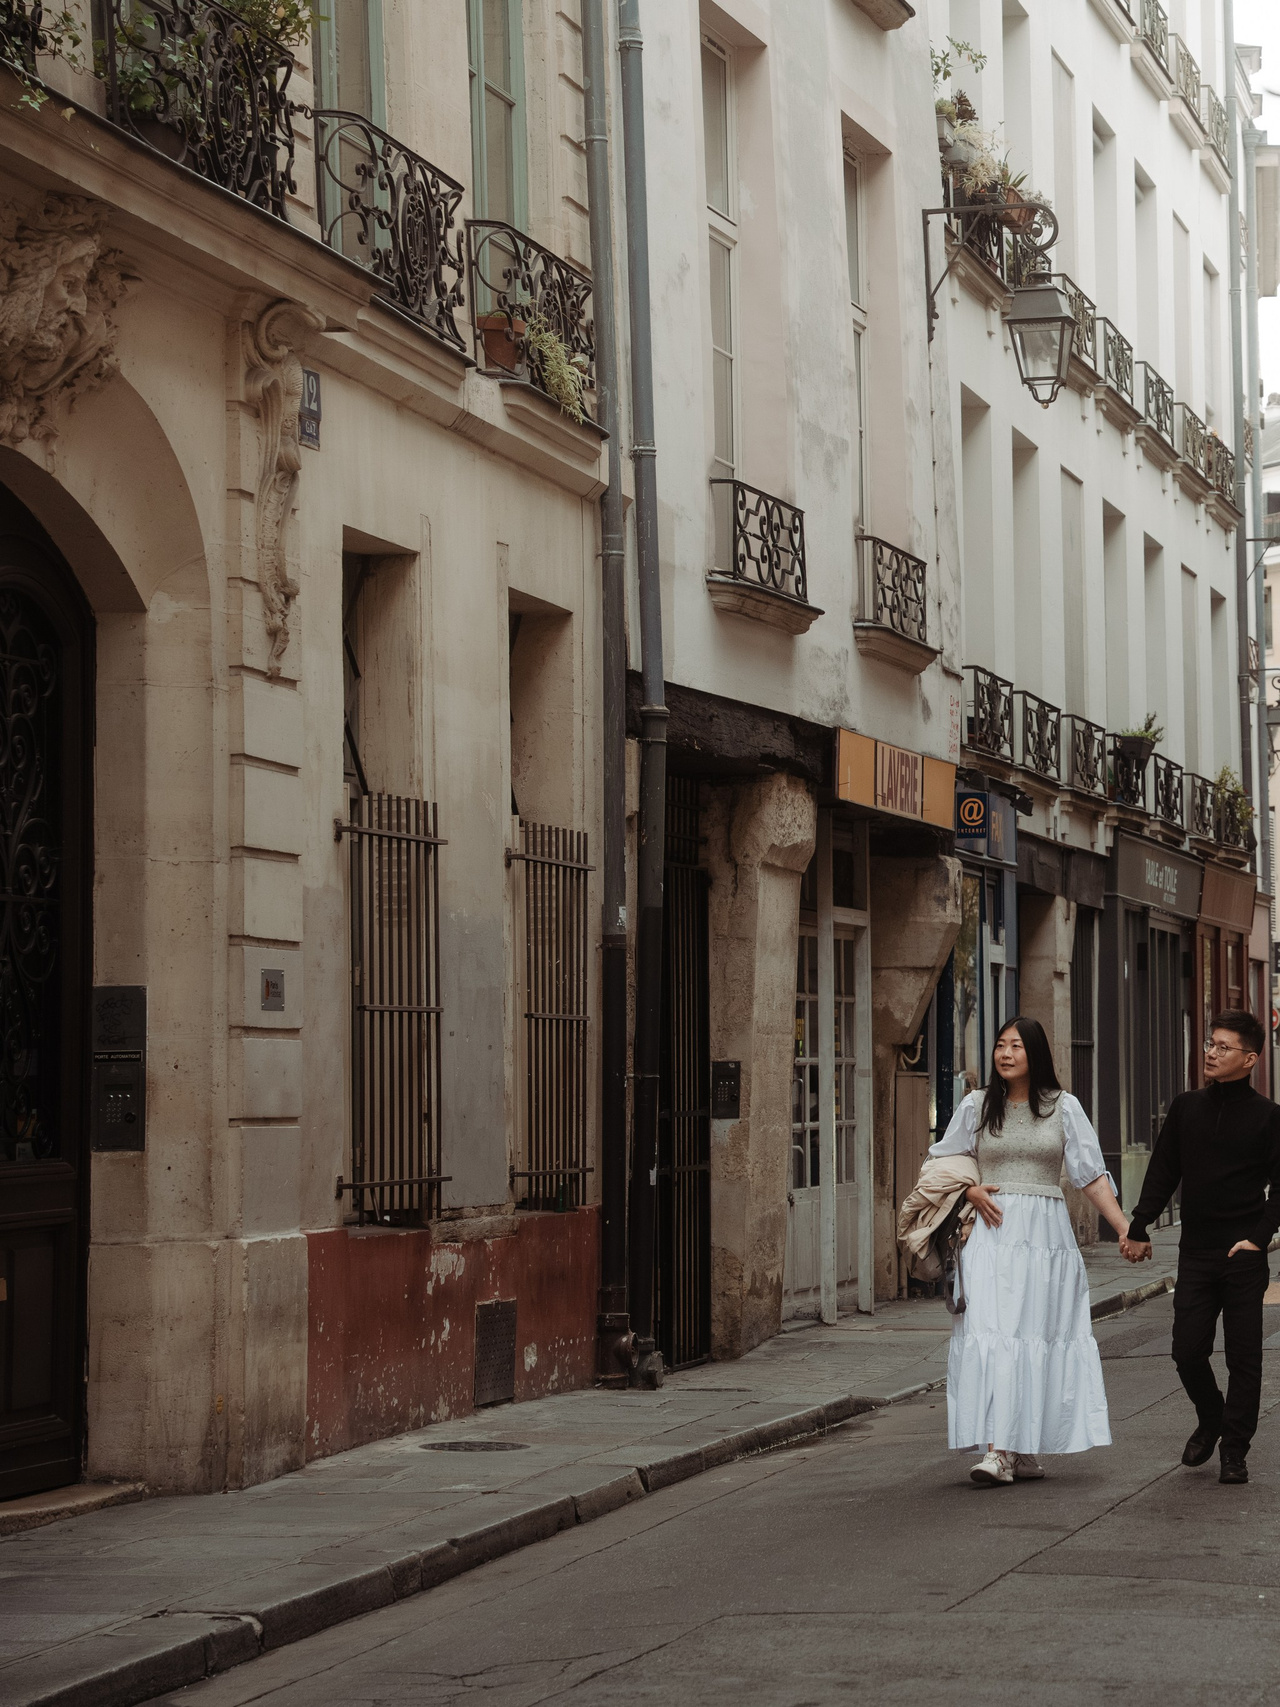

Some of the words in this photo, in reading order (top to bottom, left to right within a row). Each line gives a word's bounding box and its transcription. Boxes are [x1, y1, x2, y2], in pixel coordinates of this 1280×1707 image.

[303, 372, 318, 412] 12
[305, 420, 317, 436] GAZ
[881, 746, 918, 815] LAVERIE
